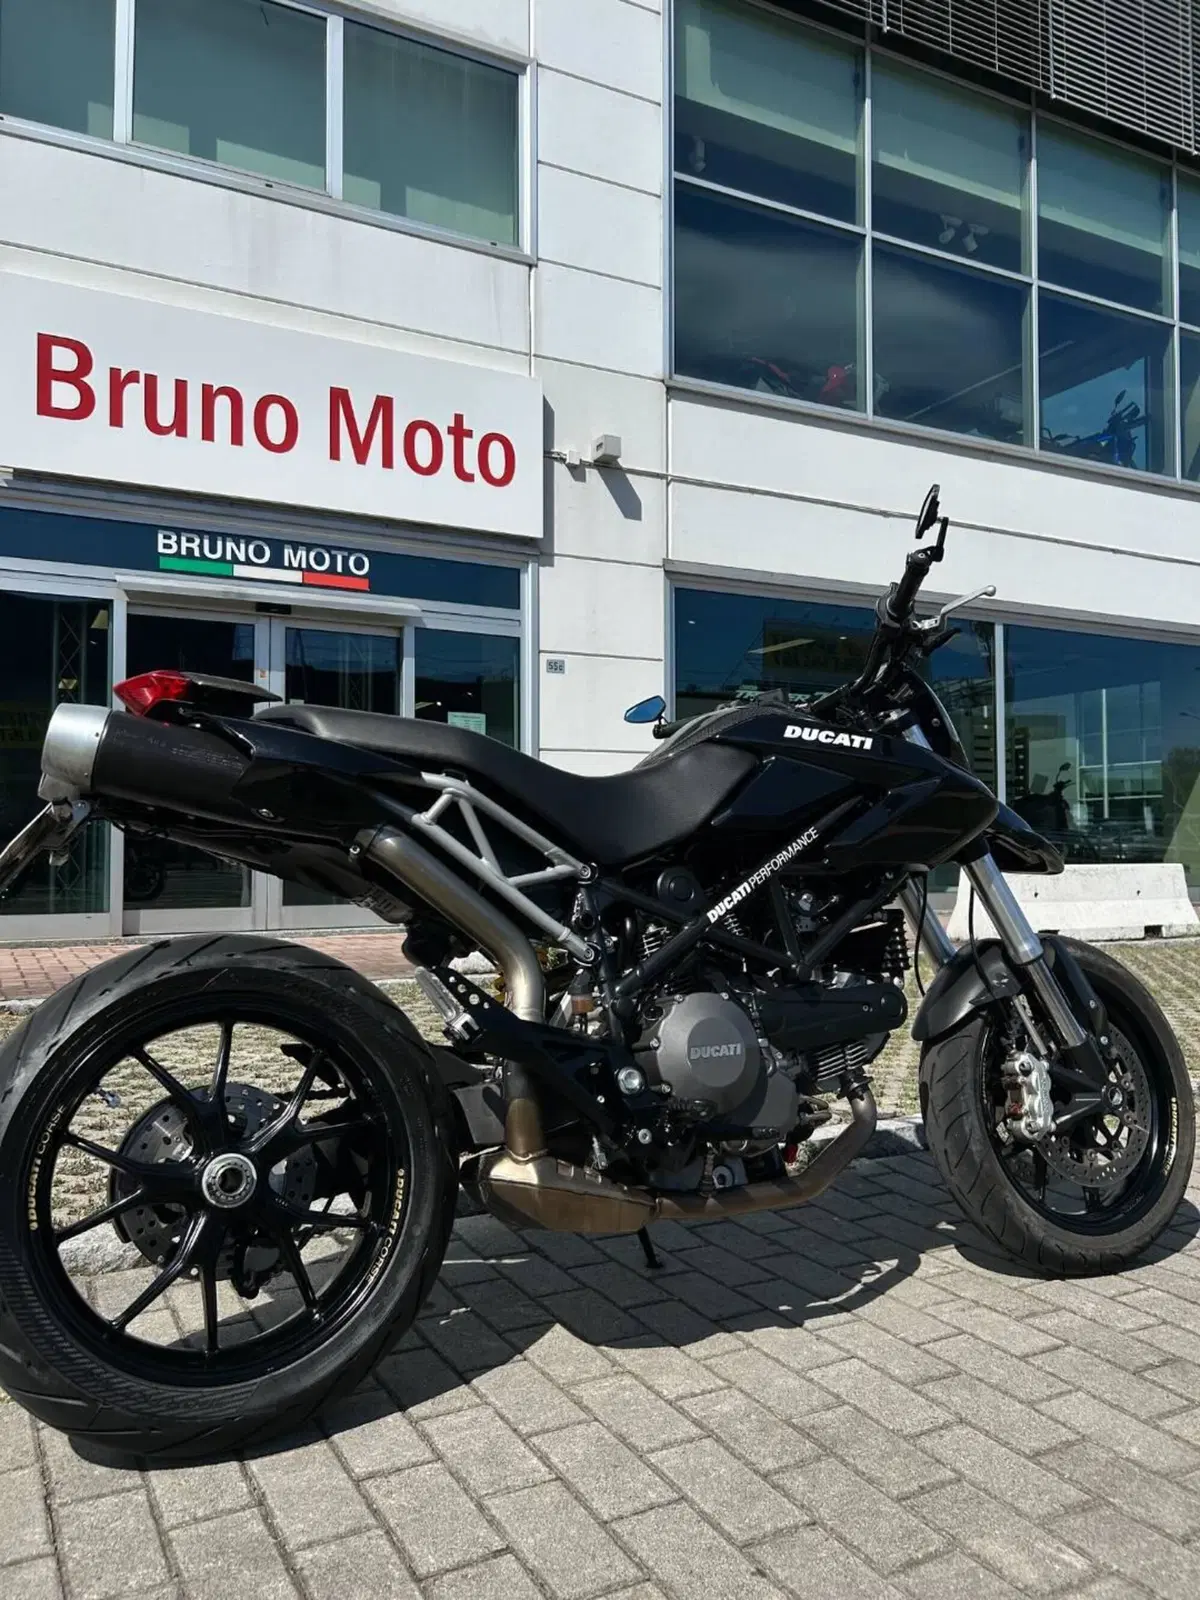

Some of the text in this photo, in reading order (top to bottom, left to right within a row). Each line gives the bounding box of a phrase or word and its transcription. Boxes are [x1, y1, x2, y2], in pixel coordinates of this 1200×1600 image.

[36, 332, 516, 488] Bruno Moto
[157, 529, 370, 576] BRUNO MOTO
[783, 725, 873, 750] DUCATI
[706, 826, 819, 924] DUCATI PERFORMANCE
[690, 1042, 741, 1060] DUCATI
[388, 1177, 405, 1236] DUCATI
